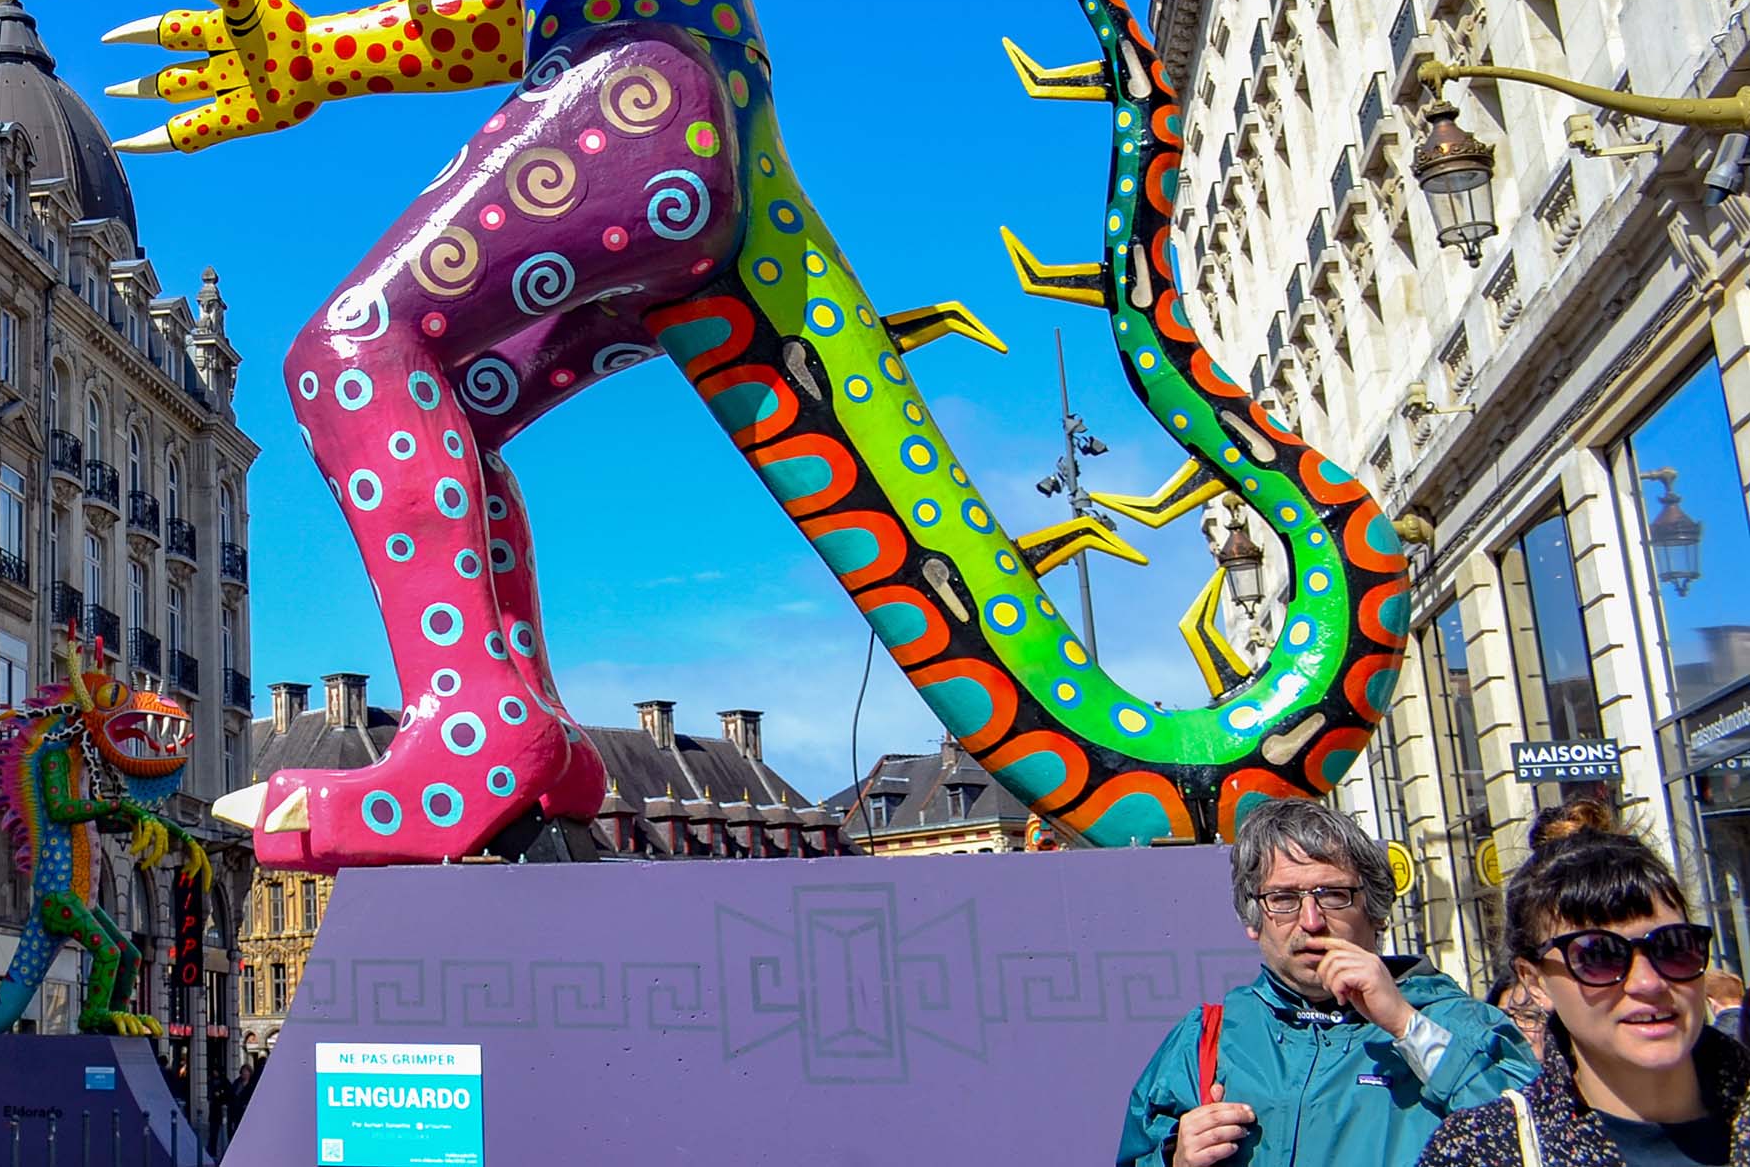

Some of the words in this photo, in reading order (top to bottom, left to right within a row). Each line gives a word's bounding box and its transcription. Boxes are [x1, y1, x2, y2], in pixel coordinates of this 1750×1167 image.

[1518, 744, 1616, 763] MAISONS
[1519, 768, 1541, 777] DU
[1555, 765, 1619, 776] MONDE
[178, 872, 197, 984] HIPPO
[339, 1054, 354, 1064] NE
[362, 1054, 387, 1064] PAS
[392, 1054, 455, 1065] GRIMPER
[327, 1086, 470, 1109] LENGUARDO
[3, 1105, 63, 1118] Eldorado
